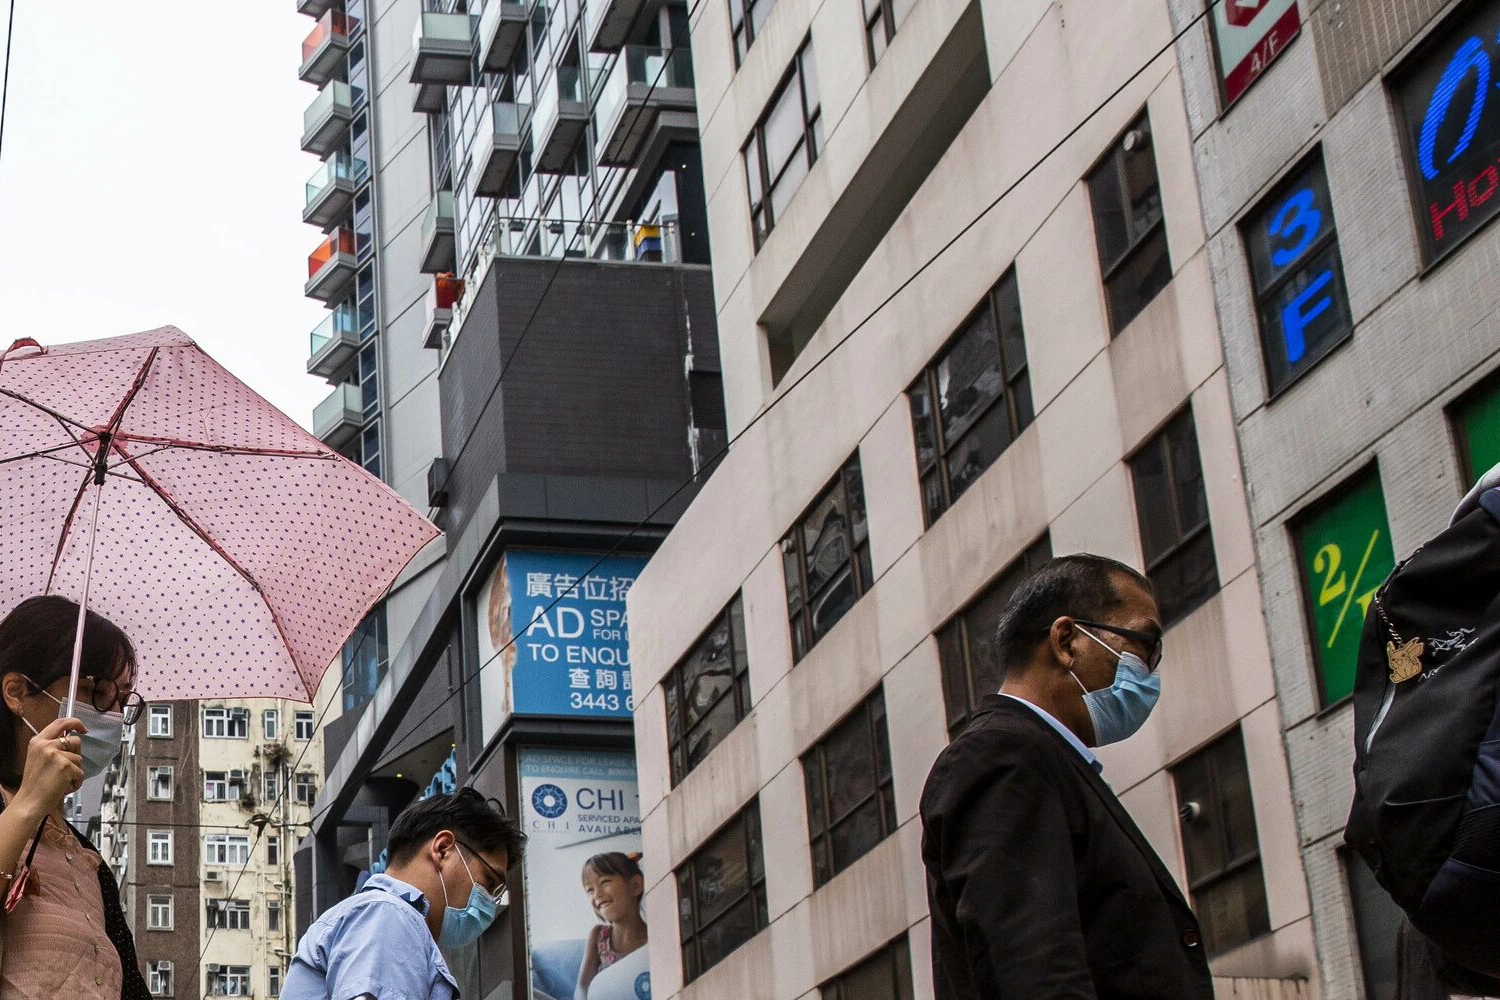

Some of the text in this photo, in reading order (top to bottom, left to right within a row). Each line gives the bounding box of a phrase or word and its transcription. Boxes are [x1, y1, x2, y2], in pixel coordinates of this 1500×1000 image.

[1250, 30, 1279, 73] 4/F
[1429, 157, 1500, 241] Ho
[526, 605, 585, 639] AD
[593, 629, 621, 641] FOR
[527, 643, 560, 663] TO
[570, 692, 620, 711] 3443
[526, 764, 540, 773] TO
[576, 787, 624, 811] CHI
[577, 814, 620, 823] SERVICED
